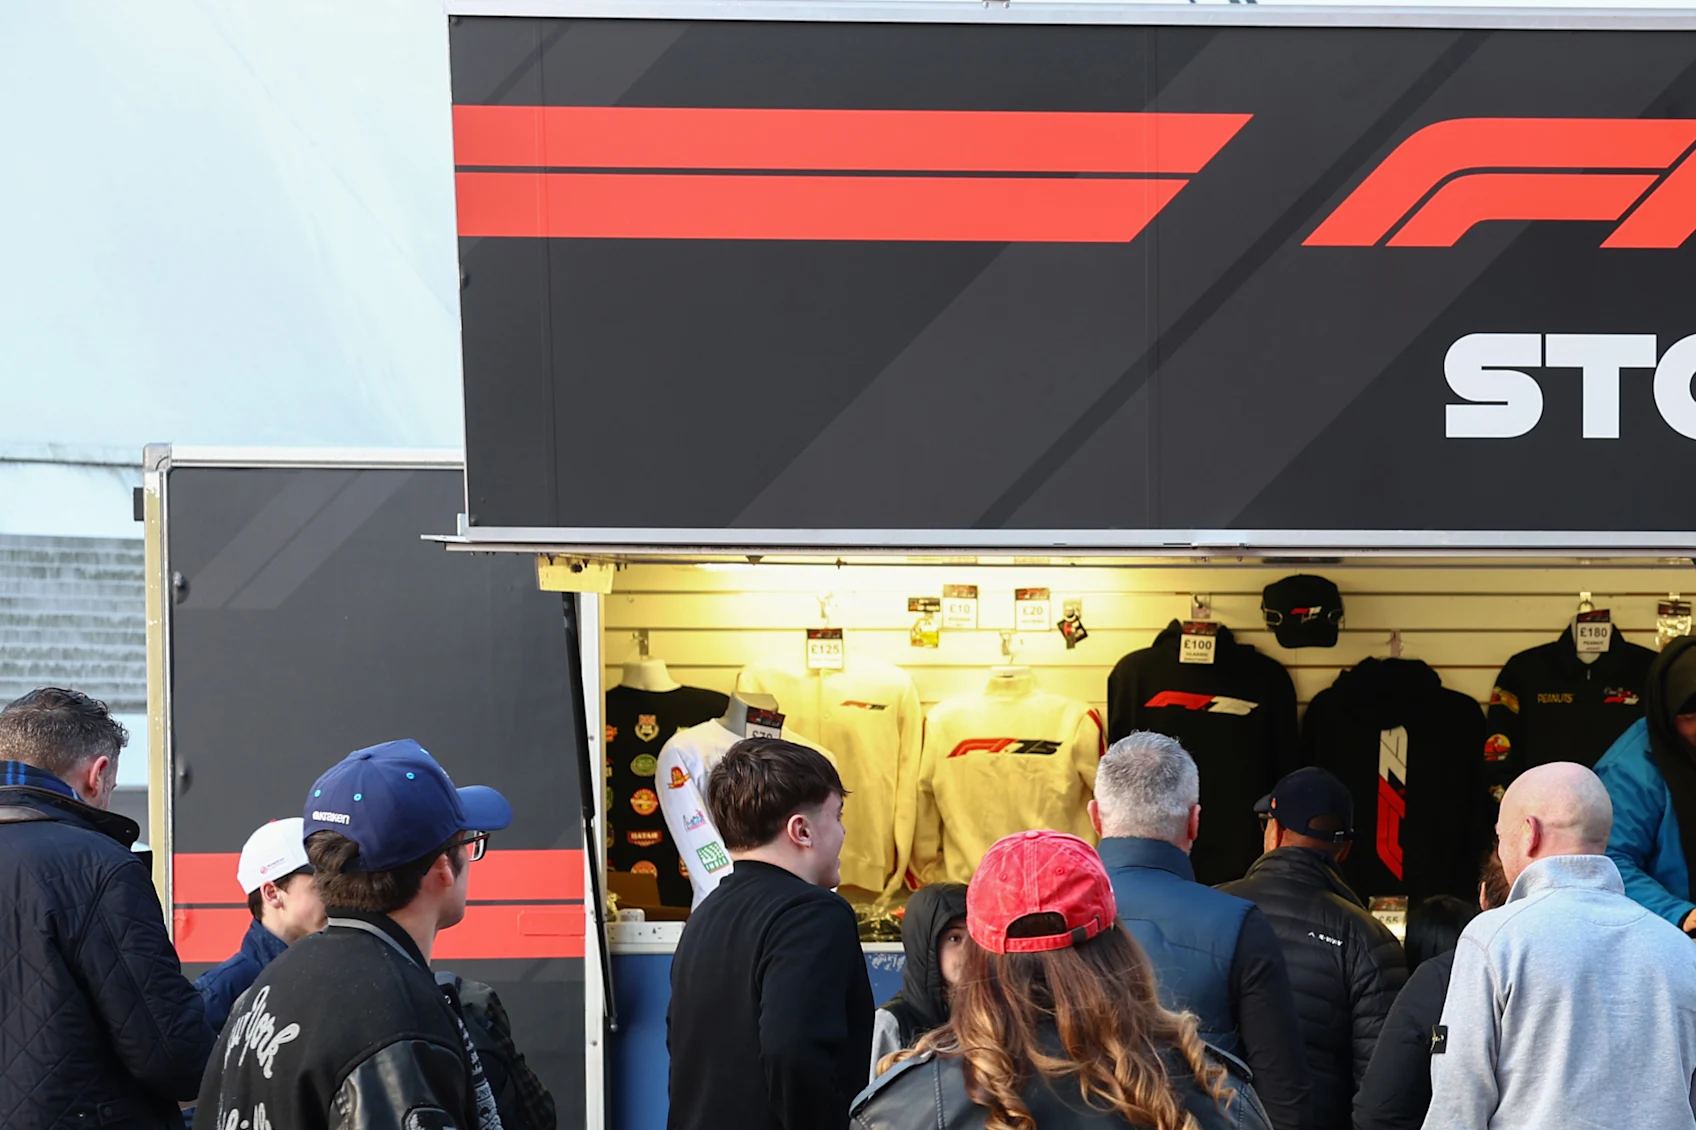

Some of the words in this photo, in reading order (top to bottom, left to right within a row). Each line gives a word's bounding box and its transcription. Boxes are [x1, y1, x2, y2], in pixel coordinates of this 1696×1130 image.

[1023, 605, 1044, 616] £20
[1580, 627, 1608, 638] £180
[811, 644, 840, 655] £125
[1184, 639, 1212, 650] £100
[1537, 693, 1574, 703] PEANUTS
